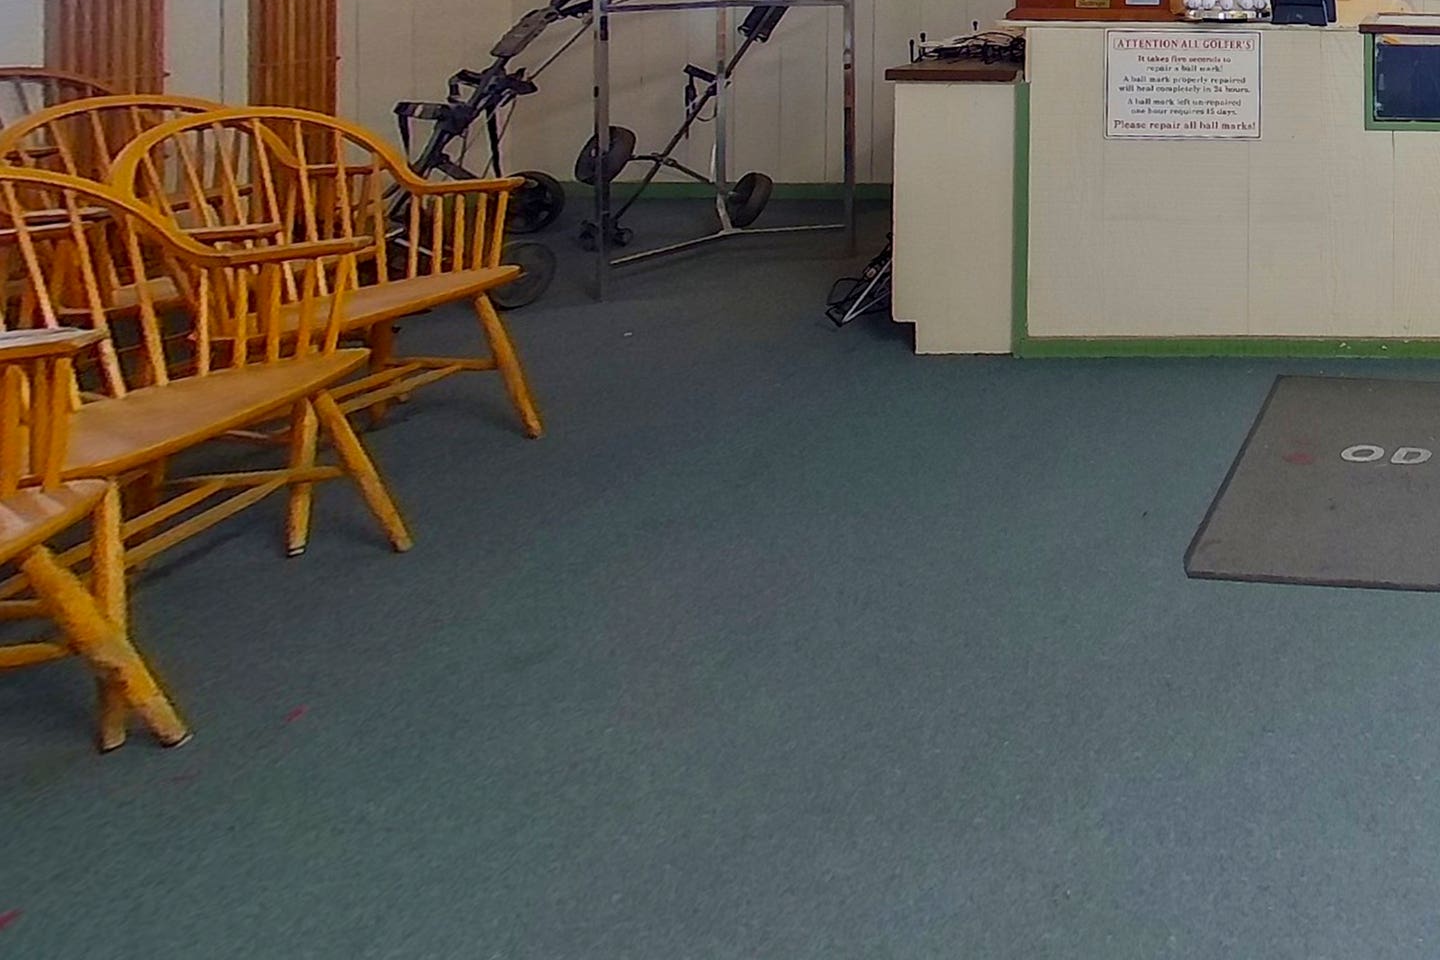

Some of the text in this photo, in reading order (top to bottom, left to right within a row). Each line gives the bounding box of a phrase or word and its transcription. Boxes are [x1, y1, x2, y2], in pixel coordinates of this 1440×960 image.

[1117, 39, 1252, 49] ATTENTION ALL GOLFER'S
[1137, 55, 1145, 63] It
[1147, 55, 1169, 63] takes
[1171, 55, 1187, 63] five
[1188, 55, 1221, 63] seconds
[1146, 65, 1172, 73] repair
[1172, 76, 1208, 84] properly
[1155, 85, 1201, 94] completely
[1170, 108, 1204, 116] requires
[1113, 119, 1256, 130] Please repair all ball marks!
